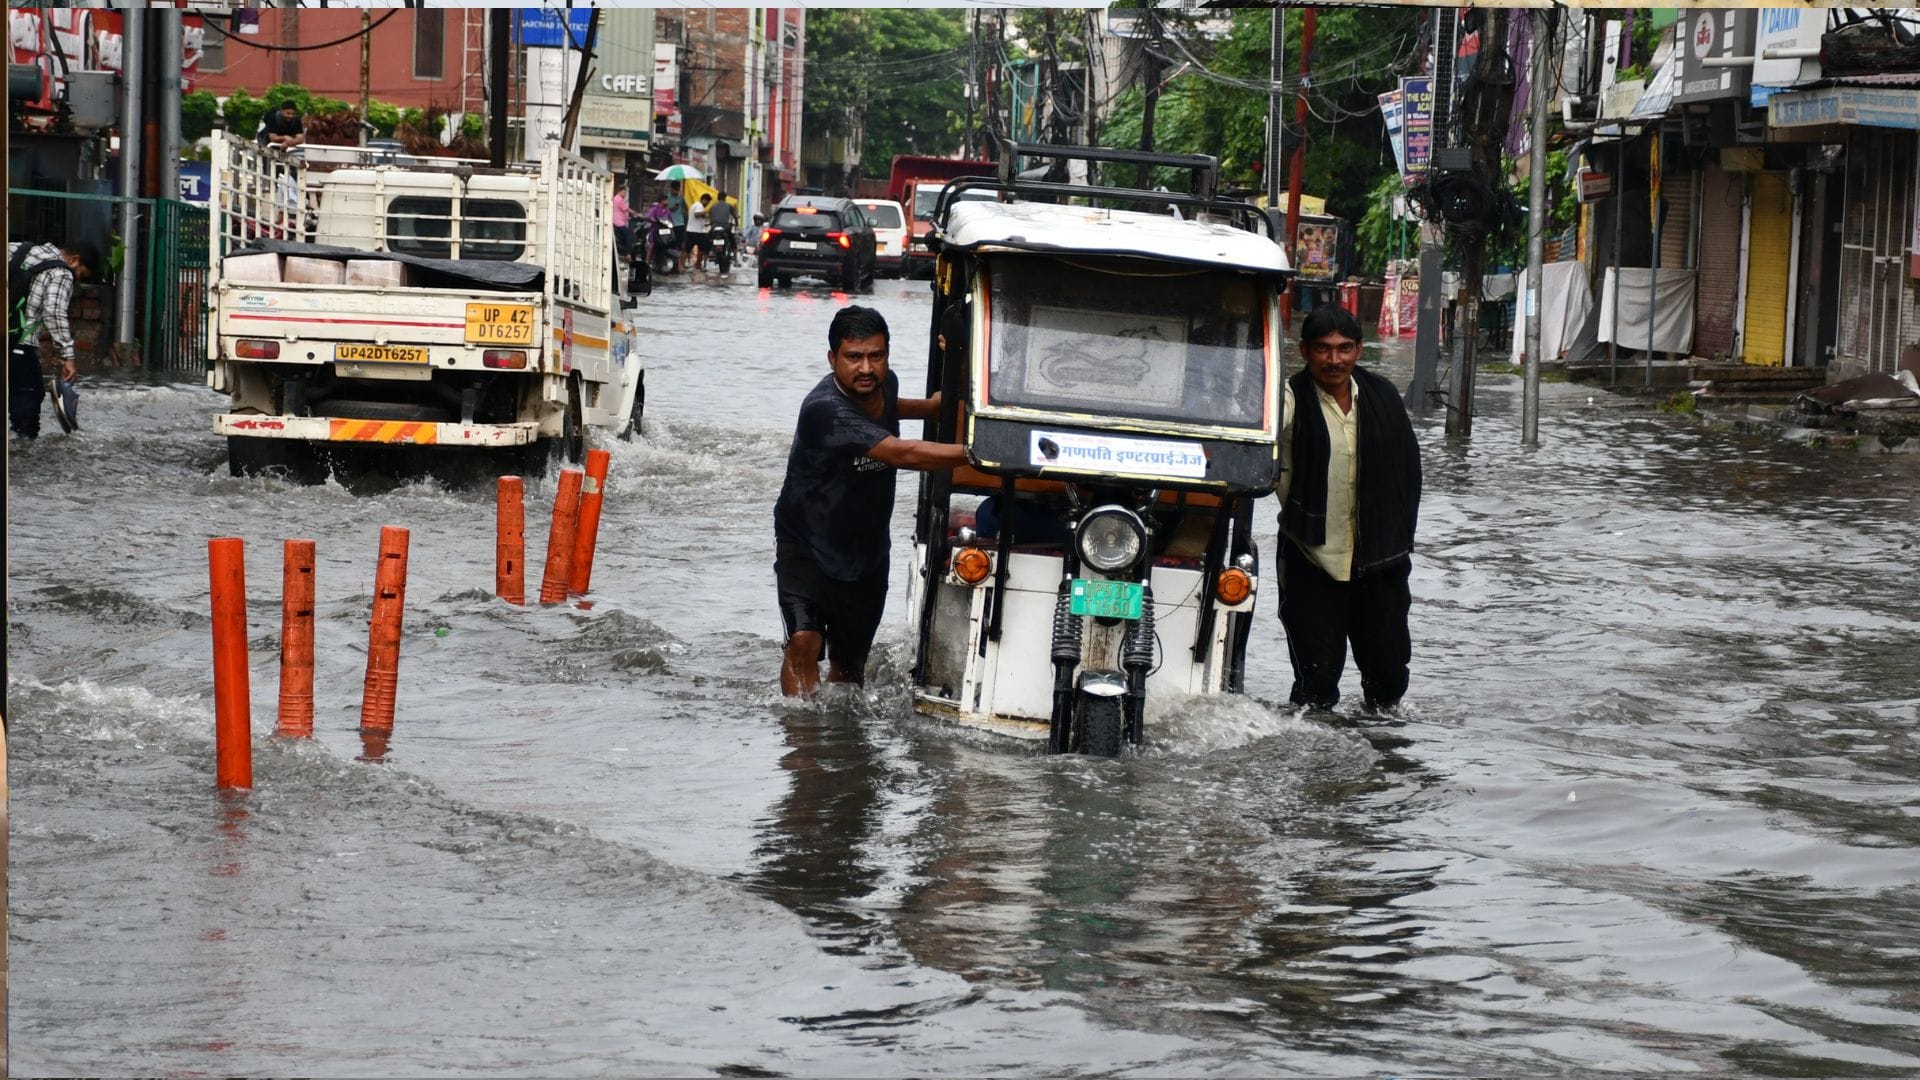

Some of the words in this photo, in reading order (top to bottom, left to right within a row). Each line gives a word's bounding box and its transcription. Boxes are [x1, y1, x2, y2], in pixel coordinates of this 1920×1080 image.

[557, 23, 589, 32] POTICO
[1768, 8, 1799, 33] DAIKIN
[602, 74, 647, 93] CAFE
[484, 309, 500, 322] UP
[511, 310, 527, 323] 42
[479, 324, 530, 339] DT6257
[340, 347, 422, 360] UP42DT6257
[1061, 446, 1112, 461] गणपति
